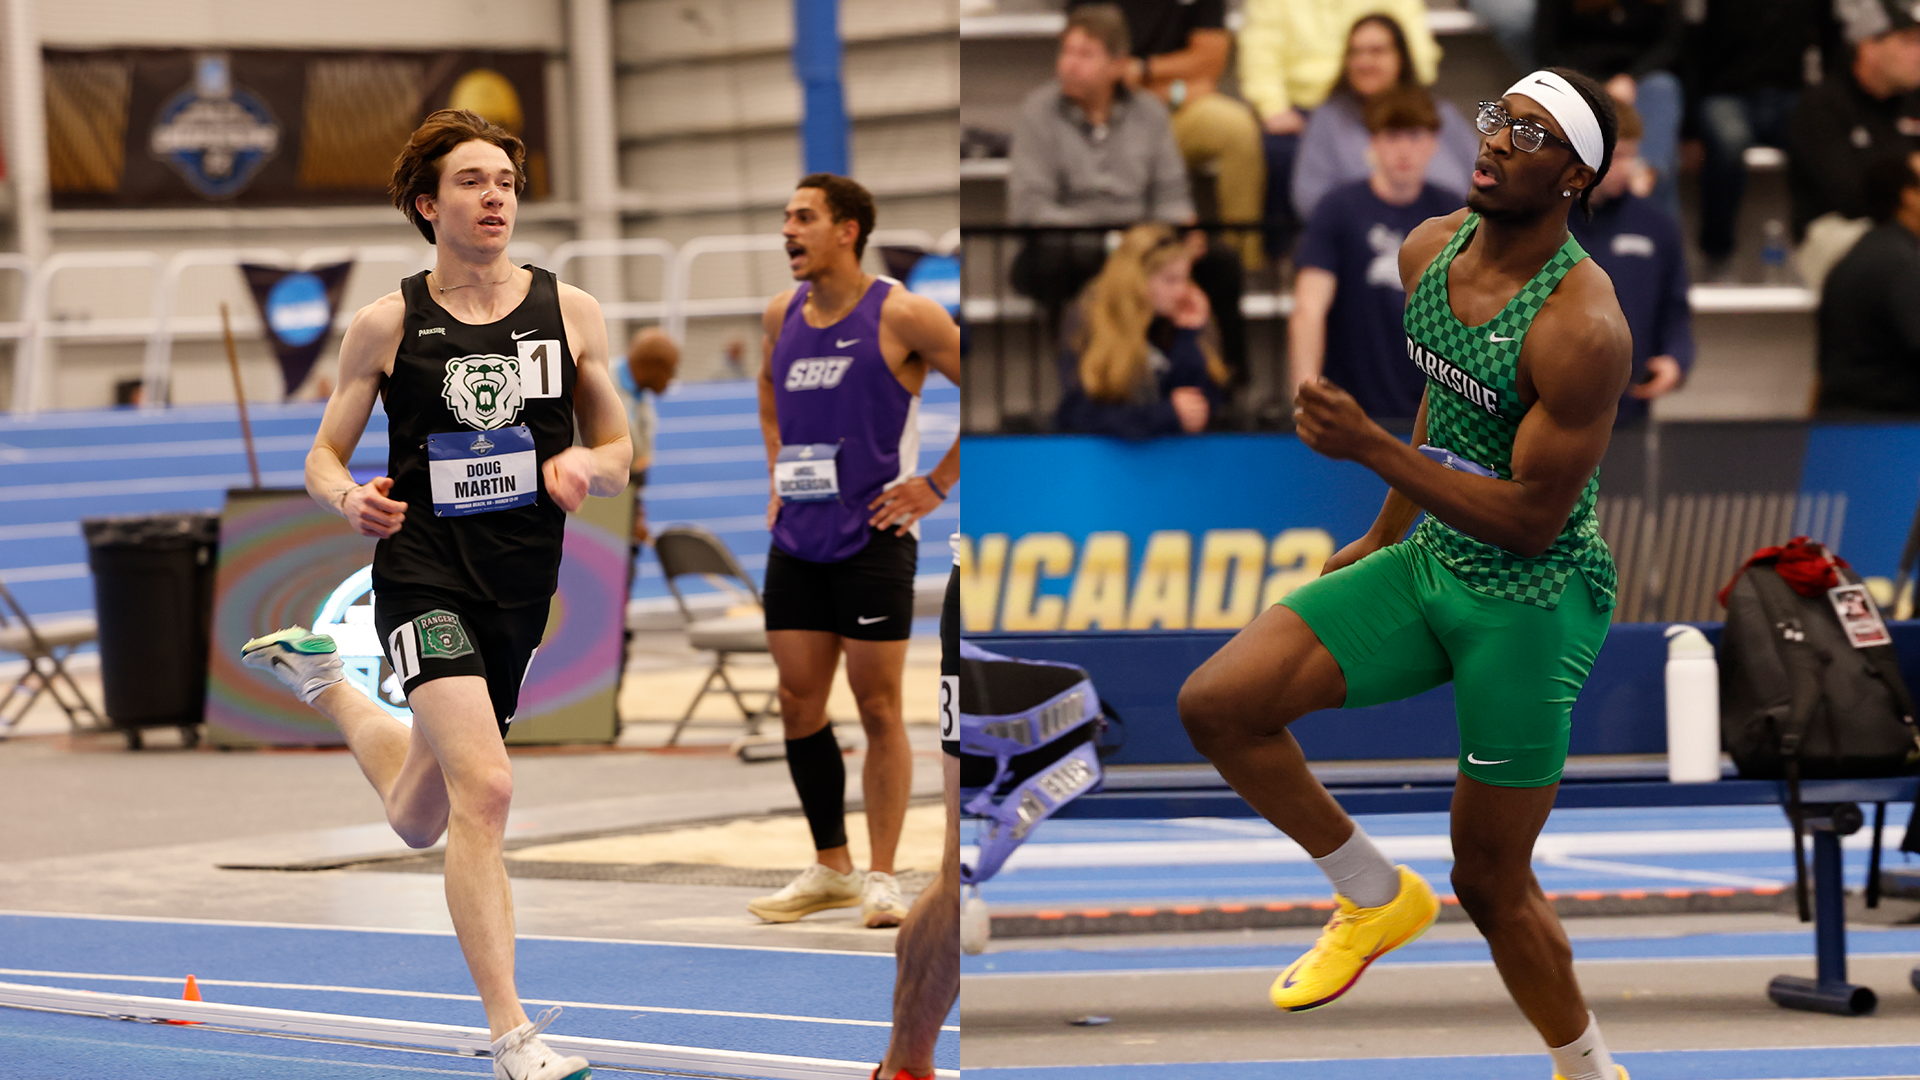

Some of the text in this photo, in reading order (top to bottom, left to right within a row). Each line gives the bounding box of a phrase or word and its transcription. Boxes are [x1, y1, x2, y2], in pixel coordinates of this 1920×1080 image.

[418, 327, 446, 337] PARKSIDE
[530, 344, 550, 395] 1
[784, 356, 854, 392] SBU
[466, 461, 502, 477] DOUG
[454, 475, 516, 499] MARTIN
[420, 615, 457, 630] RANGERS
[394, 630, 409, 678] 1
[941, 680, 953, 737] 3
